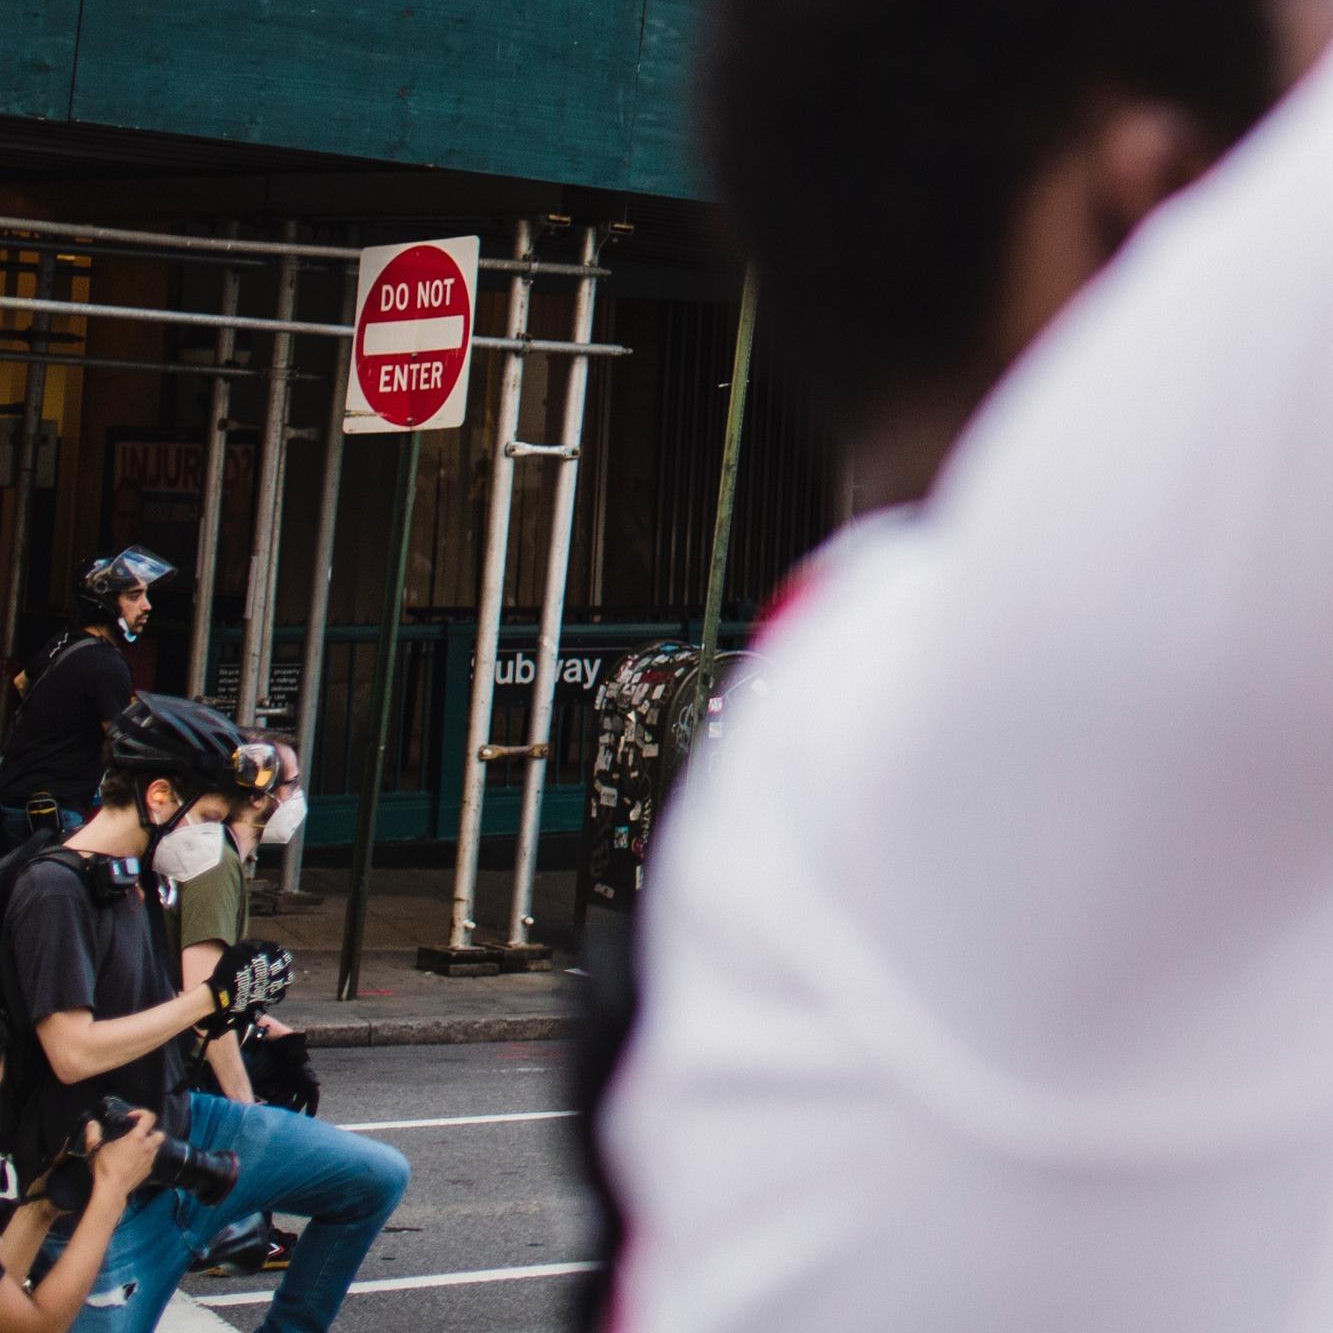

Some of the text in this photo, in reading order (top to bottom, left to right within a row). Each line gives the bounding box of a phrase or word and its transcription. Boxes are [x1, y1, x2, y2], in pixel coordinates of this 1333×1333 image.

[380, 277, 455, 313] DO NOT
[378, 360, 443, 394] ENTER
[117, 445, 252, 491] INJURD?
[470, 652, 601, 689] ubay
